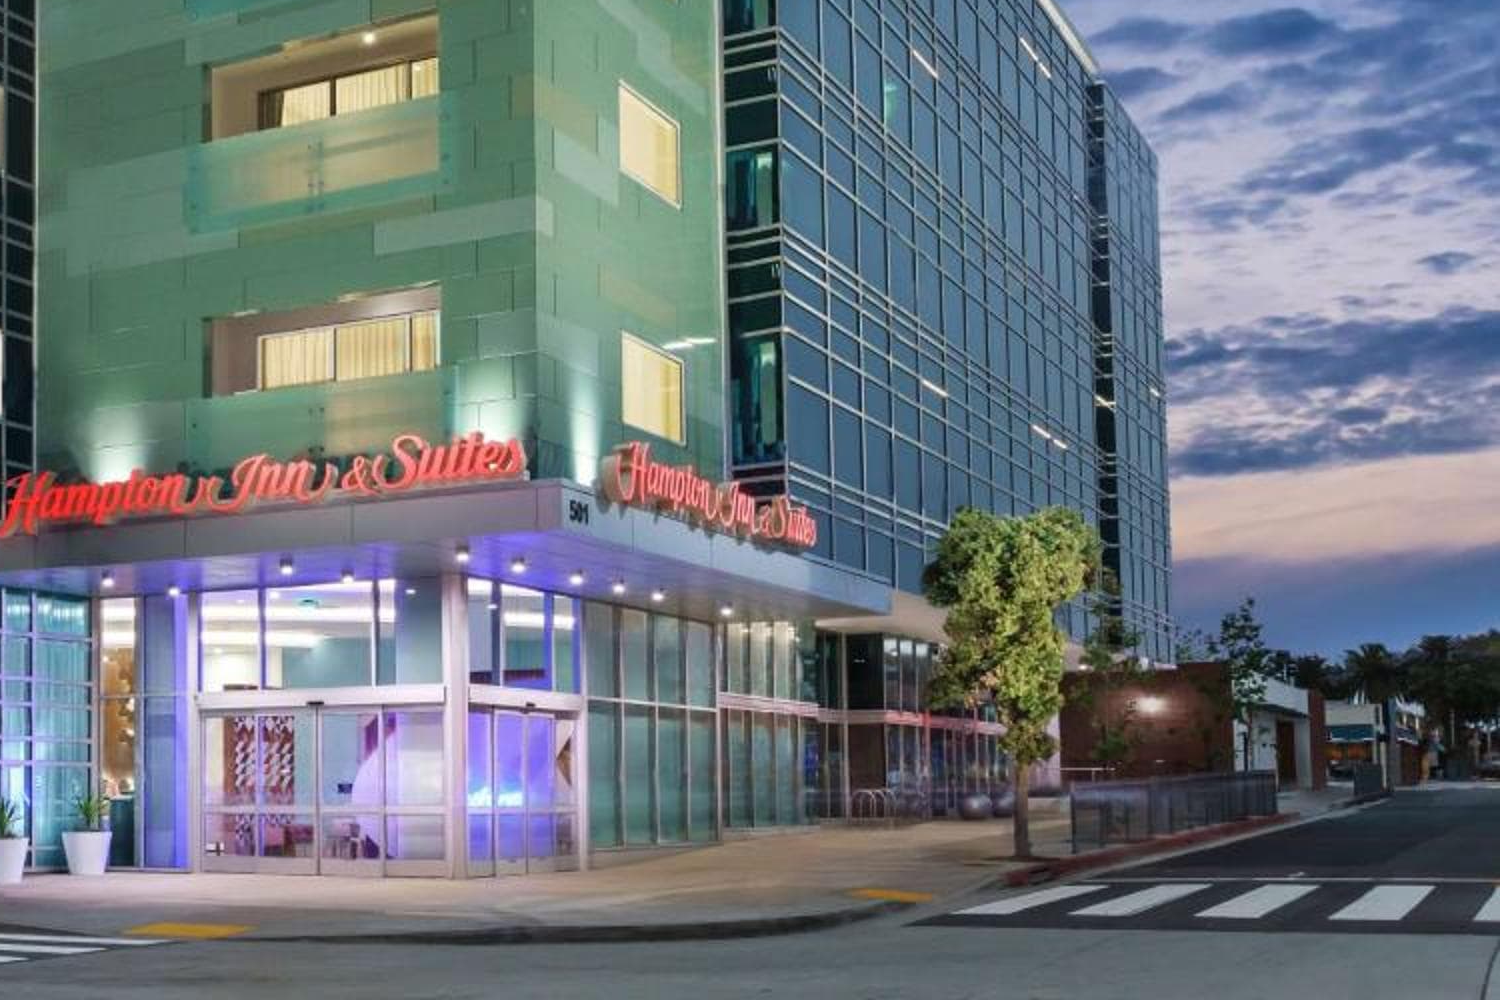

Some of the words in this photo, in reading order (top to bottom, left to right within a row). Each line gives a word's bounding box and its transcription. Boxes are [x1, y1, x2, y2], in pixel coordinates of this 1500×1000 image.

[207, 453, 338, 513] Inn
[341, 455, 372, 495] &
[372, 431, 527, 490] Suites
[569, 499, 589, 525] 501
[612, 440, 718, 521] Hampton
[714, 480, 763, 535] Inn
